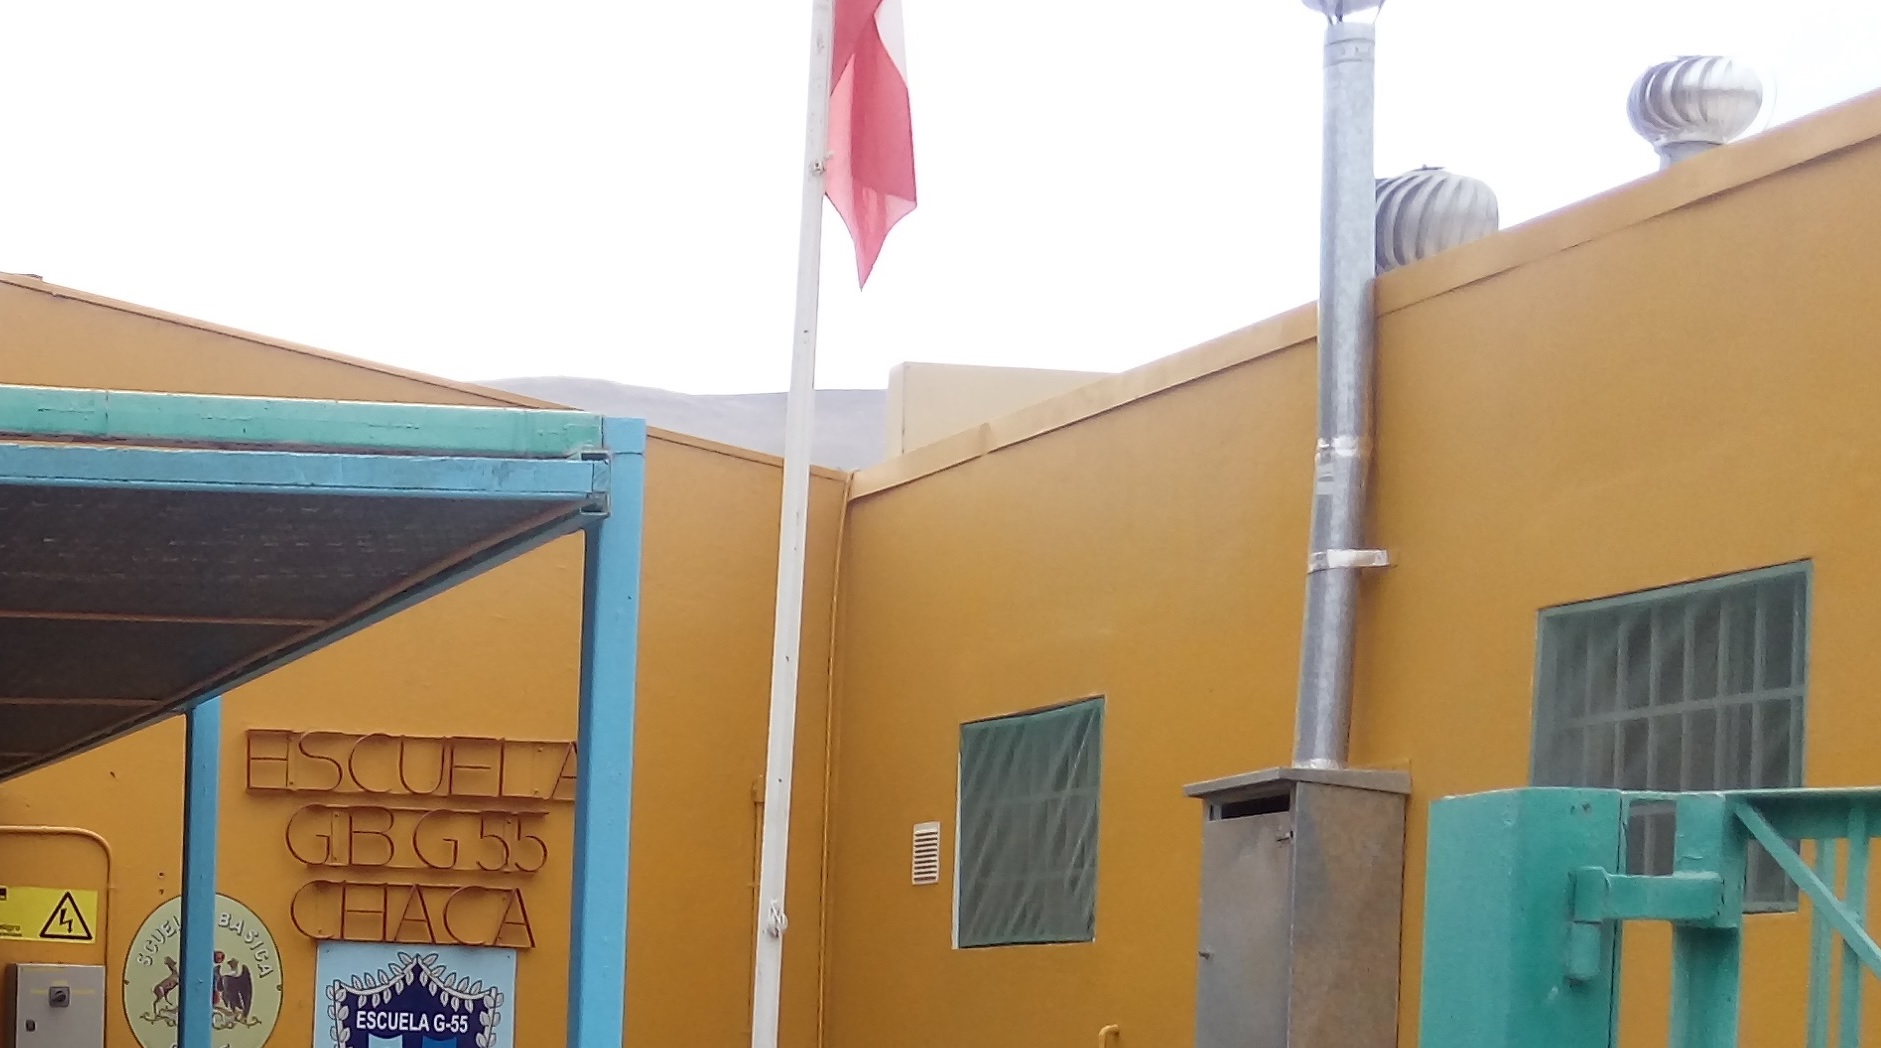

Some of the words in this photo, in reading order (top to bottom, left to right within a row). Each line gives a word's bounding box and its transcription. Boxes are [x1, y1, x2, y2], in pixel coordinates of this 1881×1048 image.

[218, 912, 274, 979] BASICA
[290, 880, 536, 949] CHACA
[356, 1010, 430, 1033] ESCUELA
[433, 1013, 469, 1034] G-55
